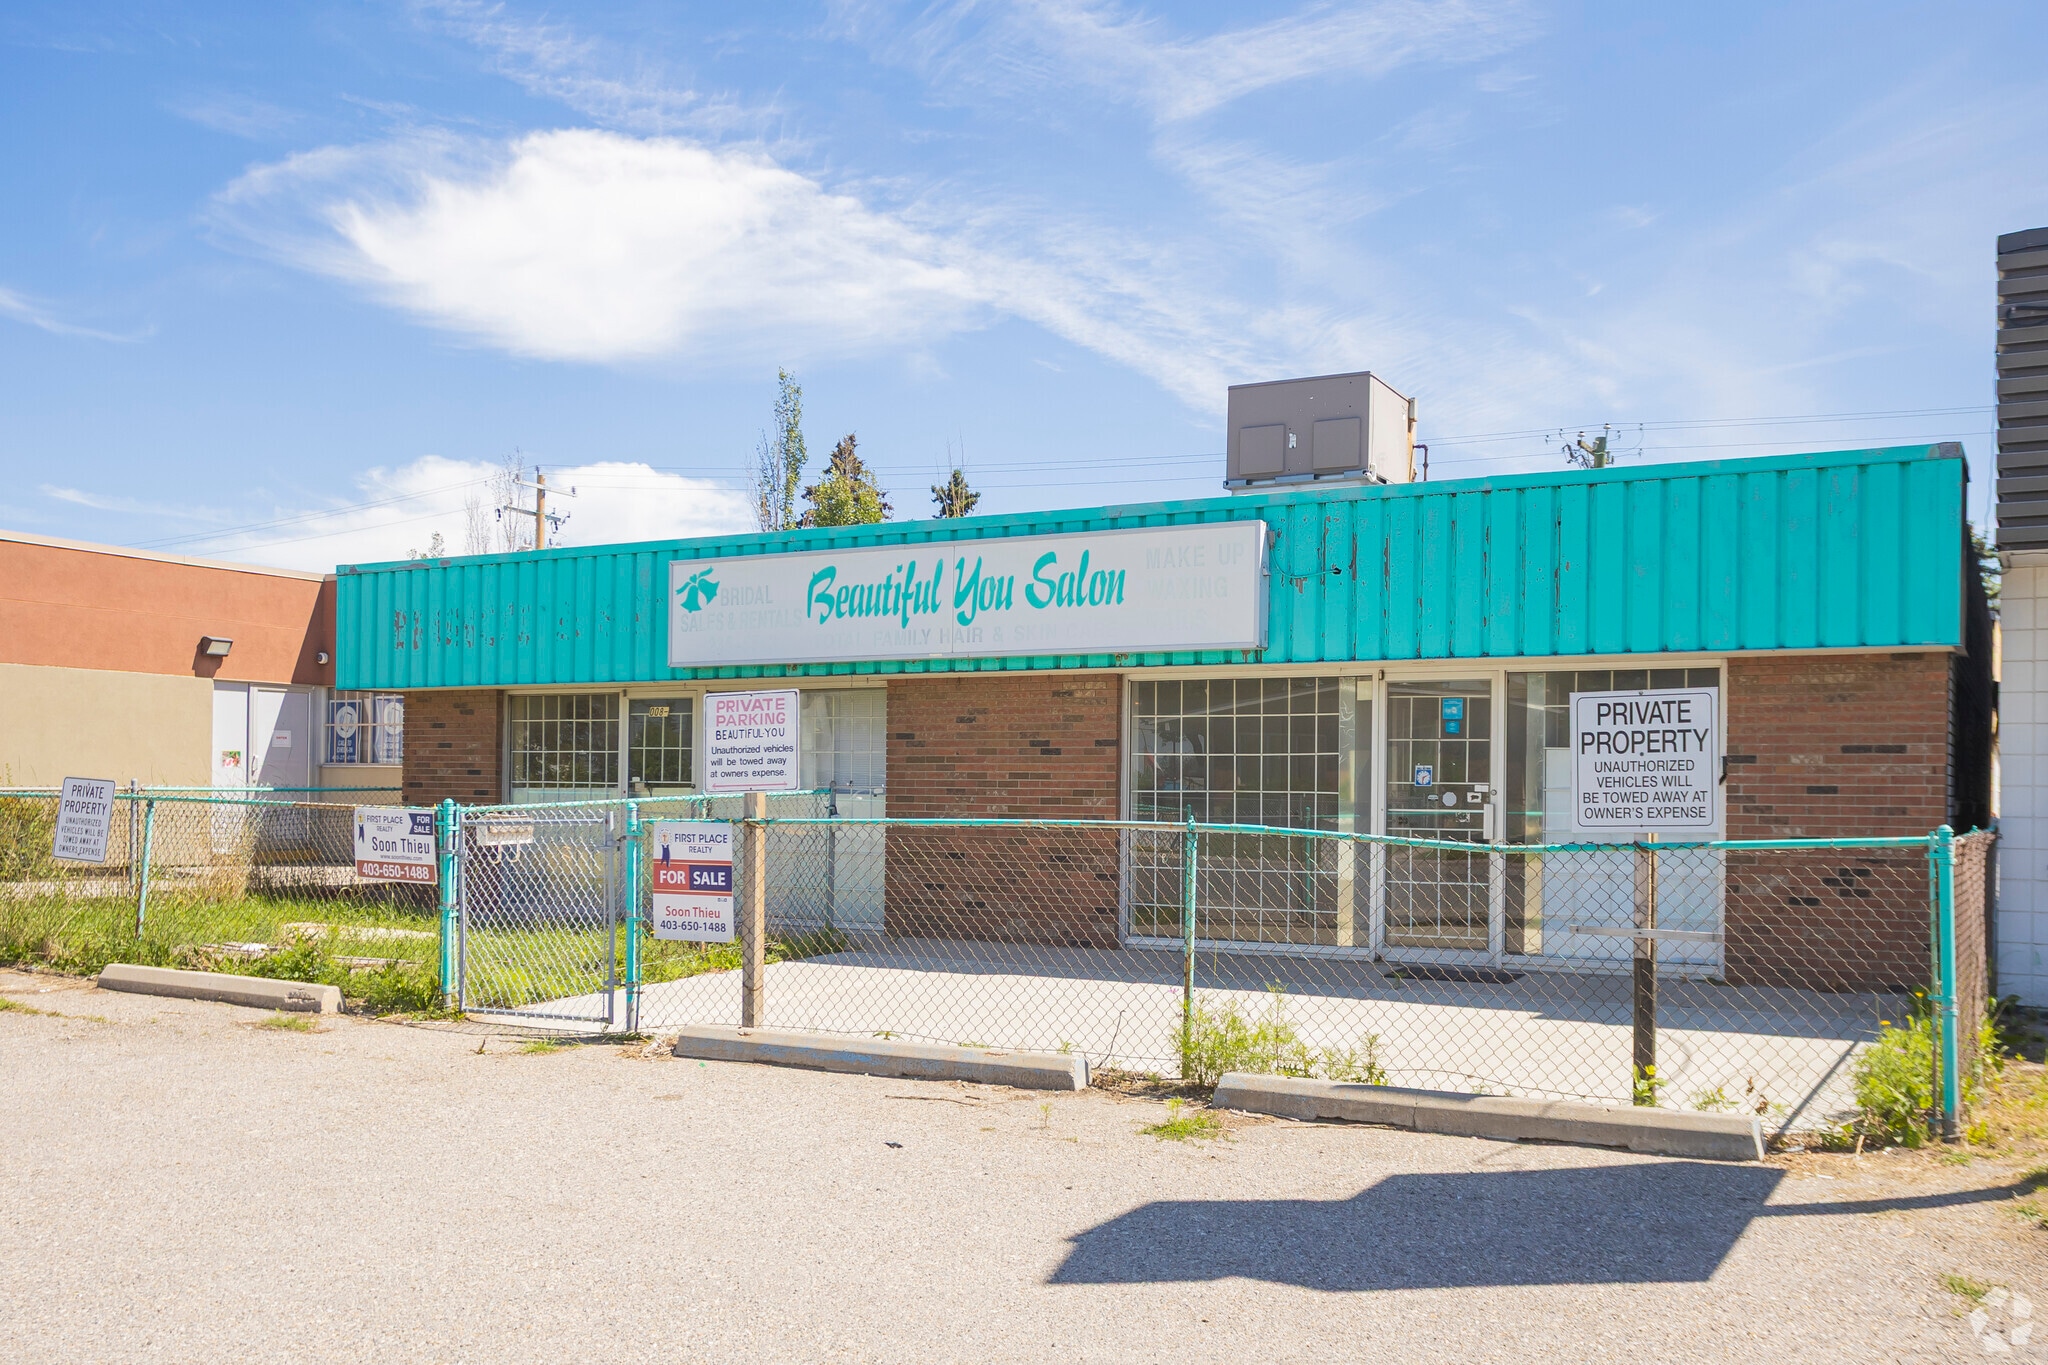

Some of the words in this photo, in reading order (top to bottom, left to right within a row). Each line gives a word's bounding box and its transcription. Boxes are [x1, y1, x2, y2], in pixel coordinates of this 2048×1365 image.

[1145, 545, 1206, 570] MAKE
[1218, 543, 1245, 566] UP
[719, 584, 774, 607] BRIDAL
[807, 558, 944, 630] Beautiful
[953, 555, 1014, 627] You
[1024, 548, 1126, 610] Salon
[1146, 576, 1229, 601] WAXING
[680, 611, 725, 632] SALES
[738, 608, 803, 630] RENTALS
[873, 628, 931, 648] FAMILY
[939, 626, 984, 645] HAIR
[716, 697, 785, 713] PRIVATE
[716, 712, 786, 727] PARKING
[1597, 699, 1691, 726] PRIVATE
[1581, 728, 1709, 755] PROPERTY
[711, 745, 761, 755] Unauthorized
[763, 744, 794, 753] vehicles
[710, 758, 723, 766] will
[726, 758, 736, 766] be
[739, 757, 763, 765] towed
[766, 757, 787, 766] away
[1594, 759, 1695, 773] UNAUTHORIZED
[710, 770, 718, 778] at
[751, 769, 787, 778] expense.
[1596, 775, 1658, 788] VEHICLES
[1661, 775, 1693, 787] WILL
[71, 784, 105, 799] PRIVATE
[1583, 792, 1599, 804] BE
[1603, 791, 1649, 803] TOWED
[1652, 791, 1689, 803] AWAY
[1692, 790, 1708, 802] AT
[64, 800, 108, 816] PROPERTY
[1584, 807, 1644, 819] OWNER'S
[1647, 806, 1706, 818] EXPENSE
[65, 817, 102, 827] UNAUTHORIZED
[366, 815, 382, 823] FIRST
[383, 816, 403, 824] PLACE
[416, 815, 430, 824] FOR
[61, 826, 83, 835] VEHICLES
[97, 829, 104, 837] BE
[413, 825, 431, 833] SALE
[62, 835, 78, 844] TOWED
[79, 837, 93, 845] AWAY
[93, 838, 99, 846] AT
[371, 836, 397, 852] Soon
[400, 838, 430, 854] Thieu
[674, 833, 696, 843] FIRST
[699, 834, 728, 844] PLACE
[79, 846, 101, 856] EXPENSE
[362, 862, 430, 879] 403-650-1488
[659, 870, 686, 884] FOR
[693, 871, 726, 886] SALE
[665, 905, 690, 917] Soon
[692, 907, 721, 919] Thieu
[660, 920, 726, 933] 403-650-1488
